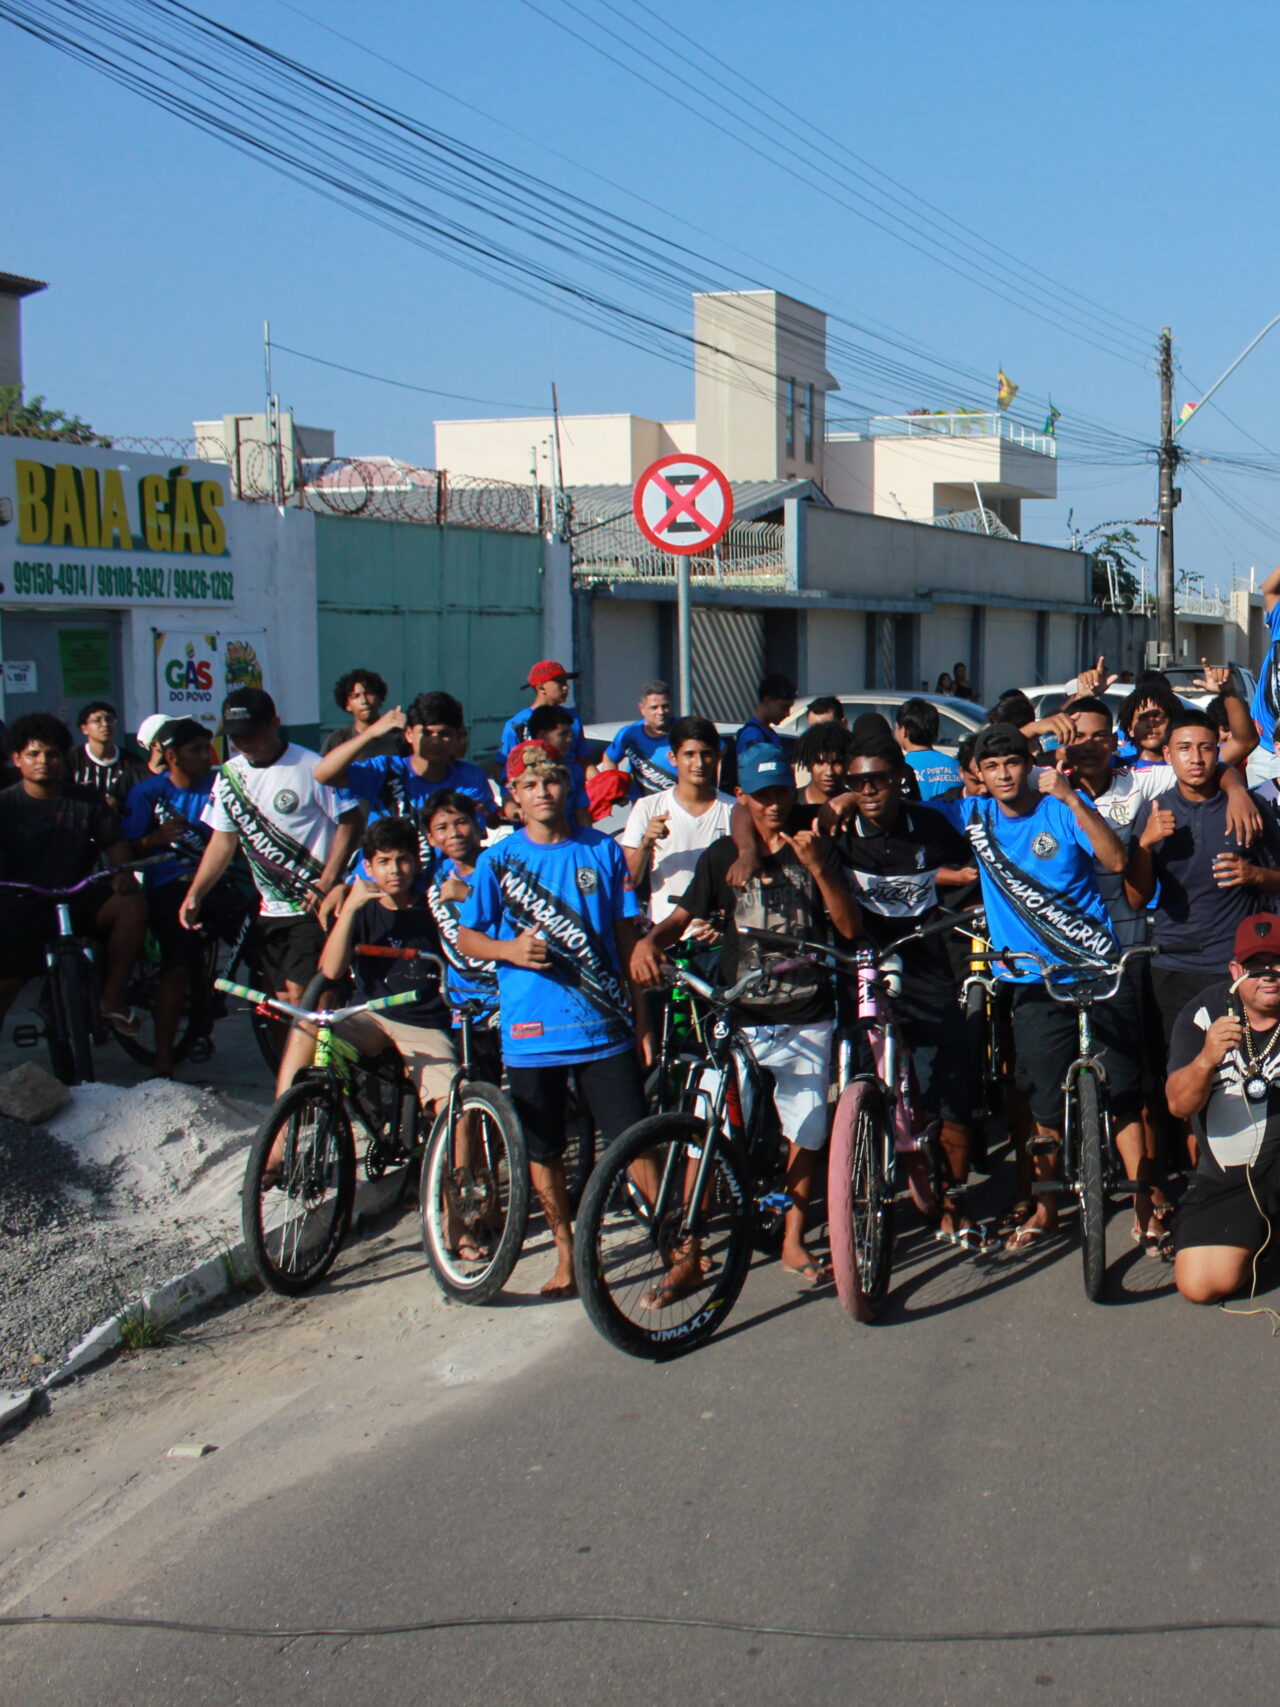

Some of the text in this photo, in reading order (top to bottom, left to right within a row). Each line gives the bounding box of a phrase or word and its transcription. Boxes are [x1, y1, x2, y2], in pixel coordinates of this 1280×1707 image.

[14, 459, 226, 555] BAIA GÁS
[14, 561, 87, 596] 99158-4974
[97, 565, 164, 598] 98108-3942
[174, 569, 234, 601] 98426-1262
[169, 692, 212, 702] DO POVO
[501, 872, 587, 947] MARABAIXO
